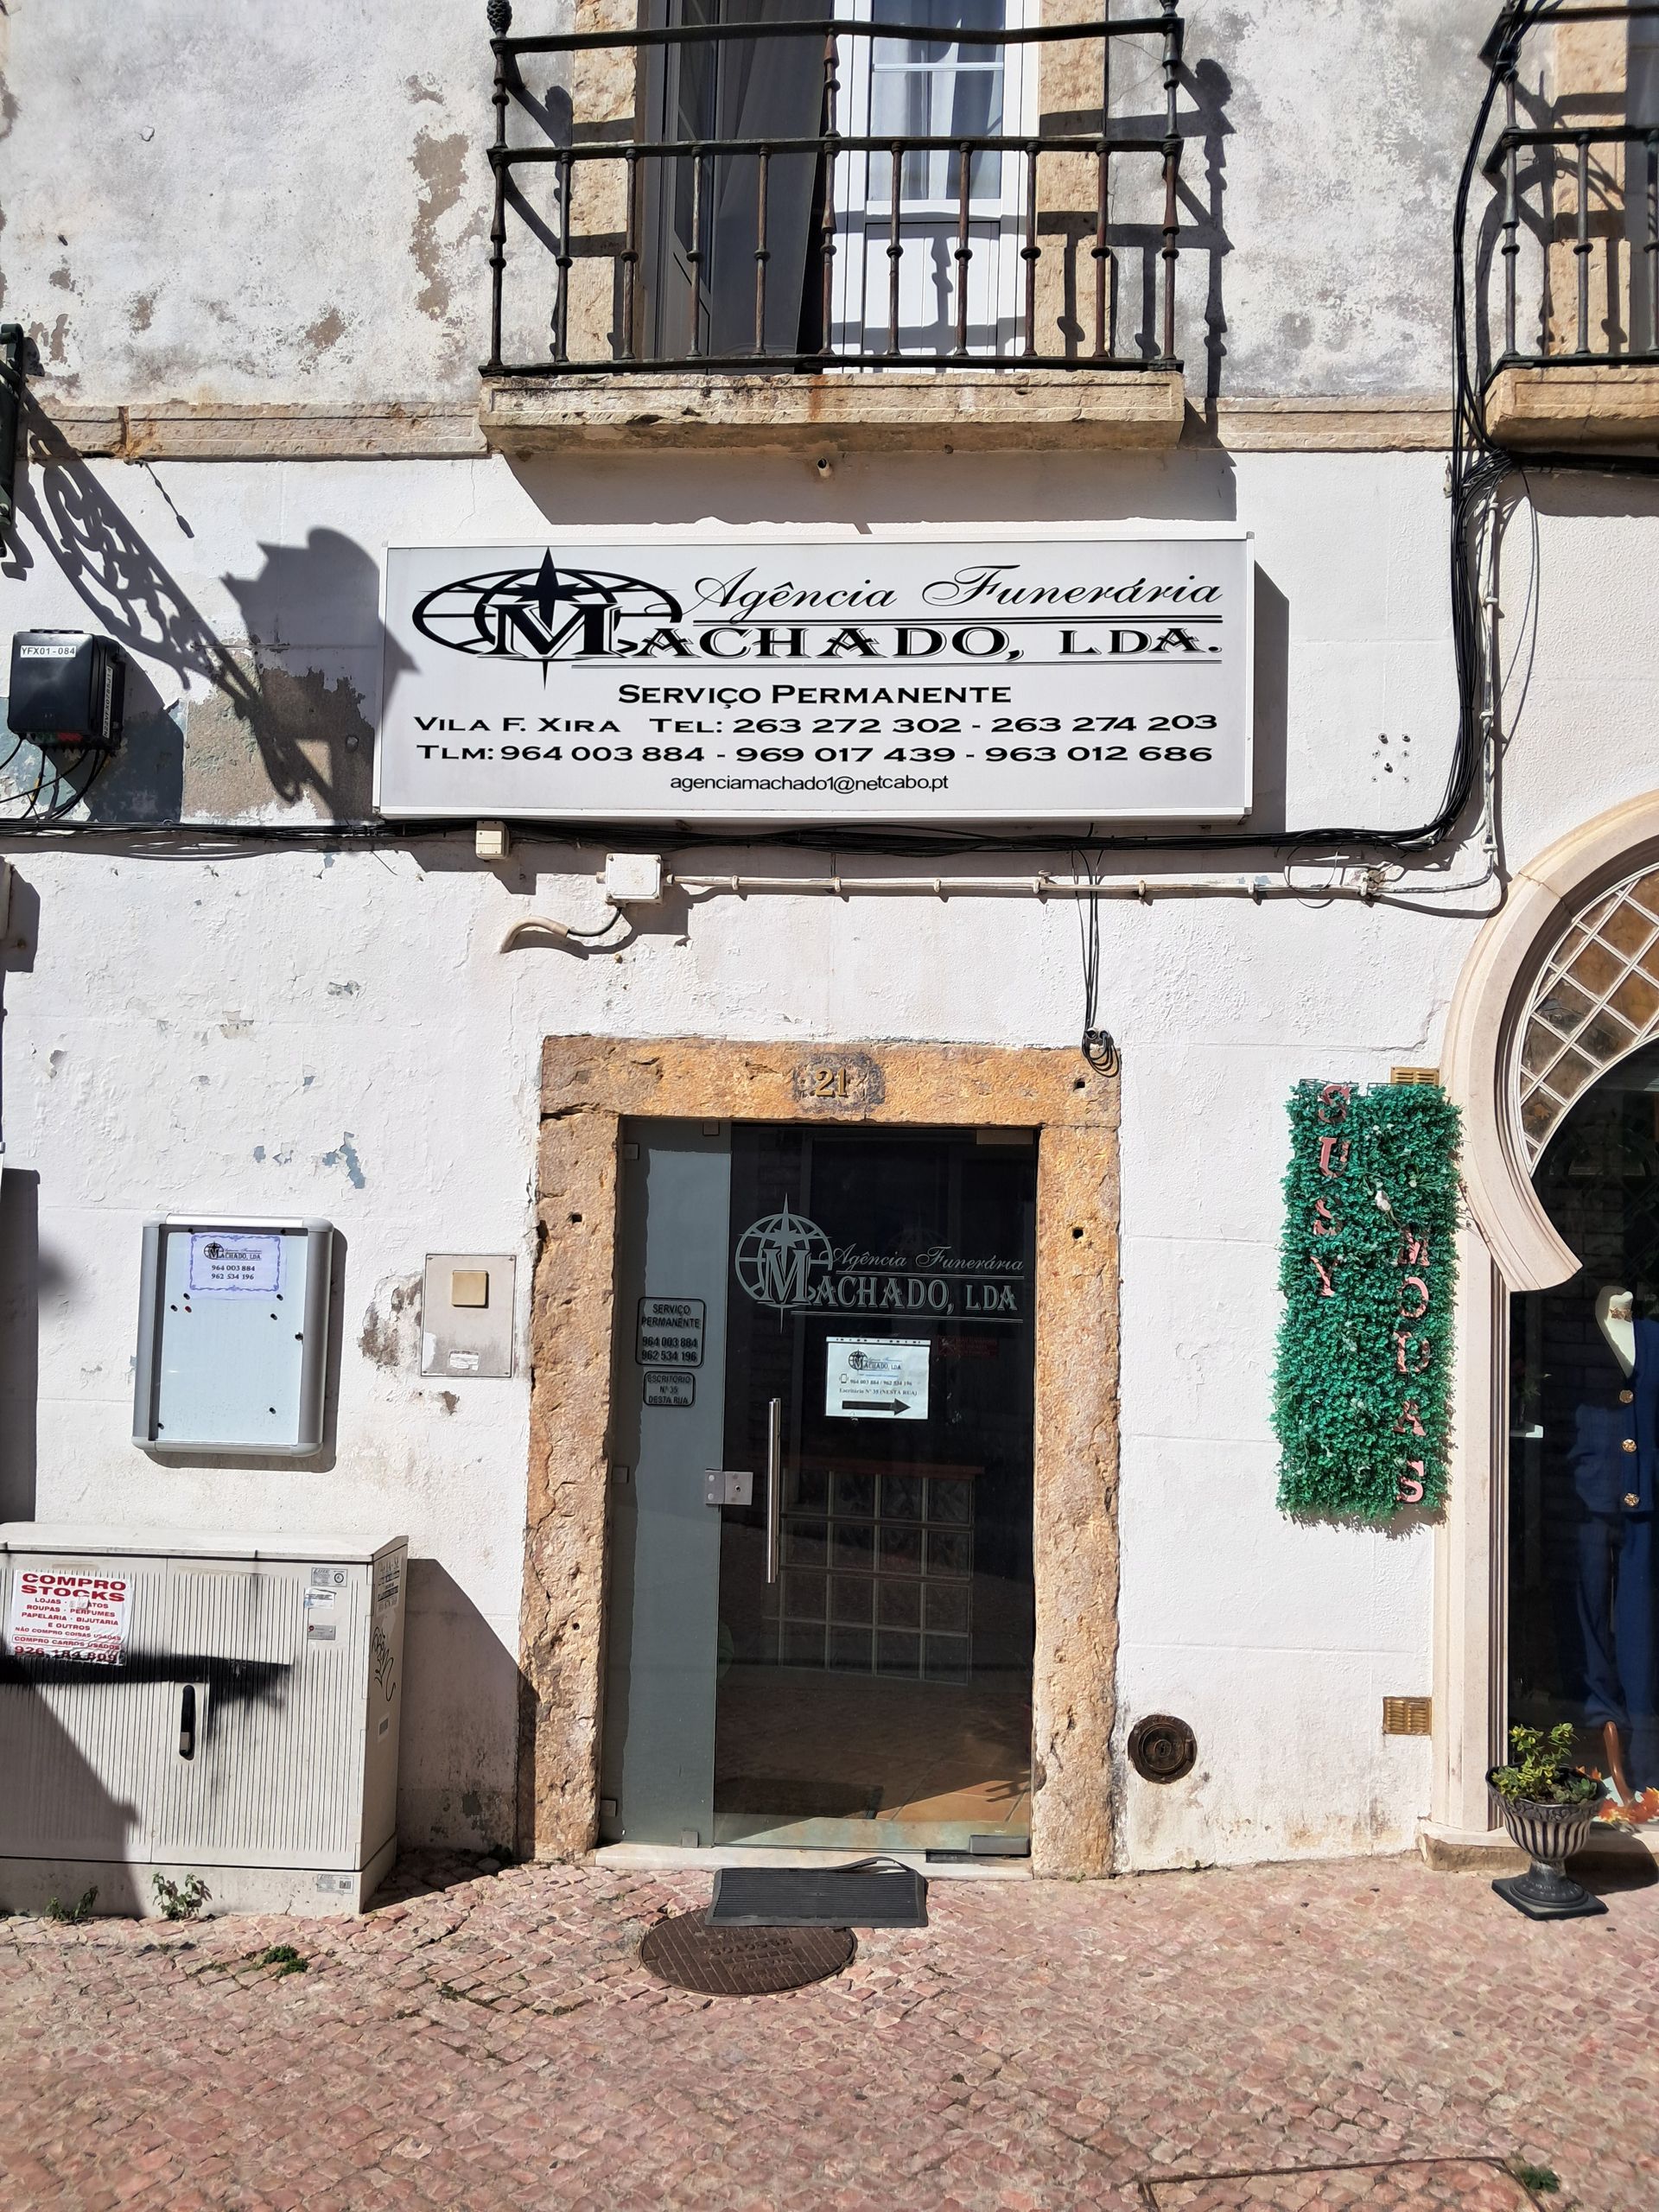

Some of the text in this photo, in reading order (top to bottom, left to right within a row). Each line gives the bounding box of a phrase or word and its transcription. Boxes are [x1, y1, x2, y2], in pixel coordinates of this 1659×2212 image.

[644, 564, 1223, 624] Agência Funerária
[1059, 627, 1222, 655] LDA.
[618, 684, 1012, 709] SERVIÇO PERMANENTE
[414, 716, 490, 732] VILA
[503, 716, 526, 732] F.
[537, 717, 620, 733] XIRA
[650, 718, 722, 734] TEL:
[733, 718, 801, 734] 263
[811, 718, 881, 734] 272
[893, 718, 961, 733] 302
[991, 717, 1061, 733] 263
[1072, 716, 1137, 732] 274
[1148, 715, 1217, 731] 203
[416, 744, 493, 760] TLM:
[500, 746, 563, 761] 964
[571, 747, 633, 761] 003
[642, 747, 705, 761] 884
[735, 747, 804, 762] 969
[815, 747, 874, 762] 017
[883, 747, 957, 762] 439
[985, 747, 1056, 762] 963
[1067, 747, 1128, 761] 012
[1139, 746, 1213, 762] 686
[670, 775, 949, 794] agenciamachado1@netcabo.pt
[815, 1067, 848, 1096] 21
[819, 1243, 1024, 1272] Agência Funerária
[965, 1285, 1018, 1311] LDA
[652, 1303, 691, 1316] SERVIÇO
[641, 1316, 701, 1328] PERMANENTE
[642, 1336, 698, 1348] 964 003 884
[641, 1350, 698, 1362] 962 534 196
[648, 1395, 672, 1404] DESTA
[22, 1573, 127, 1591] COMPRO
[21, 1584, 125, 1602] STOCKS
[21, 1611, 119, 1625] PAPELARIA BIJUTARIA
[70, 1608, 116, 1618] PERFUMES
